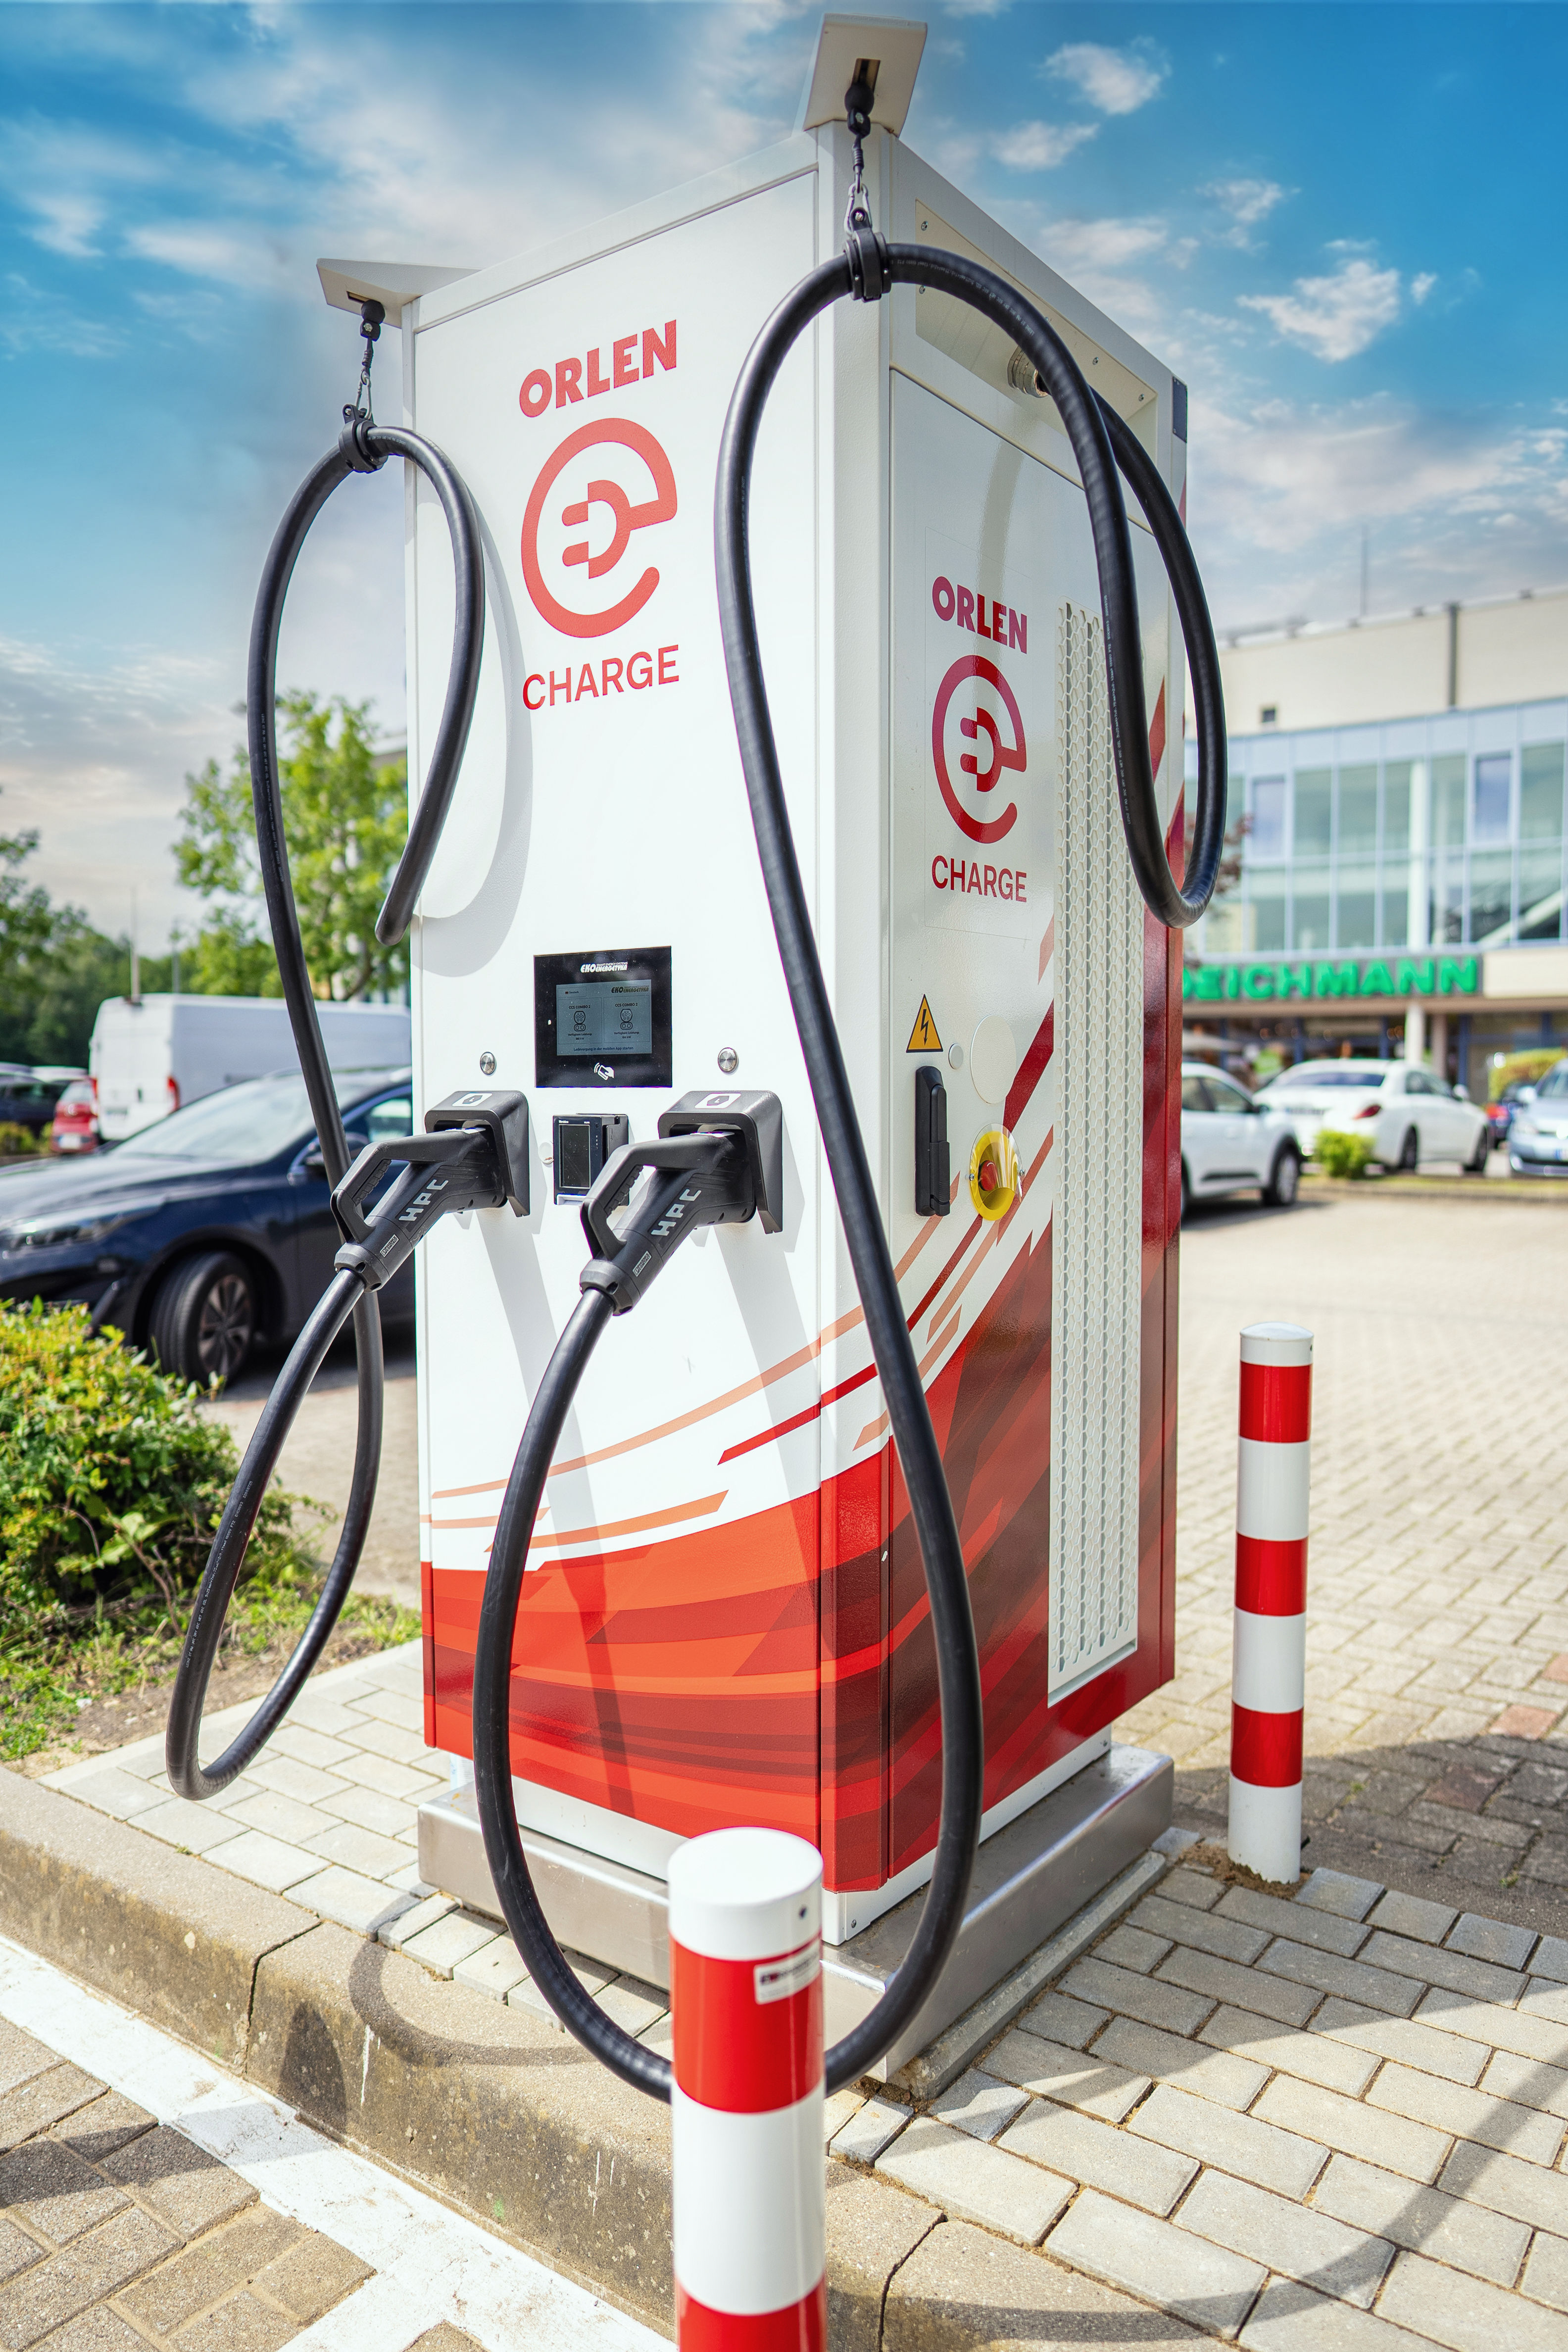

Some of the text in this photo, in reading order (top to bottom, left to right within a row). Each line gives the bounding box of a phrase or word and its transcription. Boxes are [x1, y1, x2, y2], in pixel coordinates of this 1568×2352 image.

[519, 319, 677, 418] ORLEN
[932, 576, 1027, 654] ORLEN
[522, 644, 679, 711] CHARGE
[932, 855, 1027, 902] CHARGE
[398, 1179, 448, 1221] HPC
[651, 1189, 701, 1236] HPC
